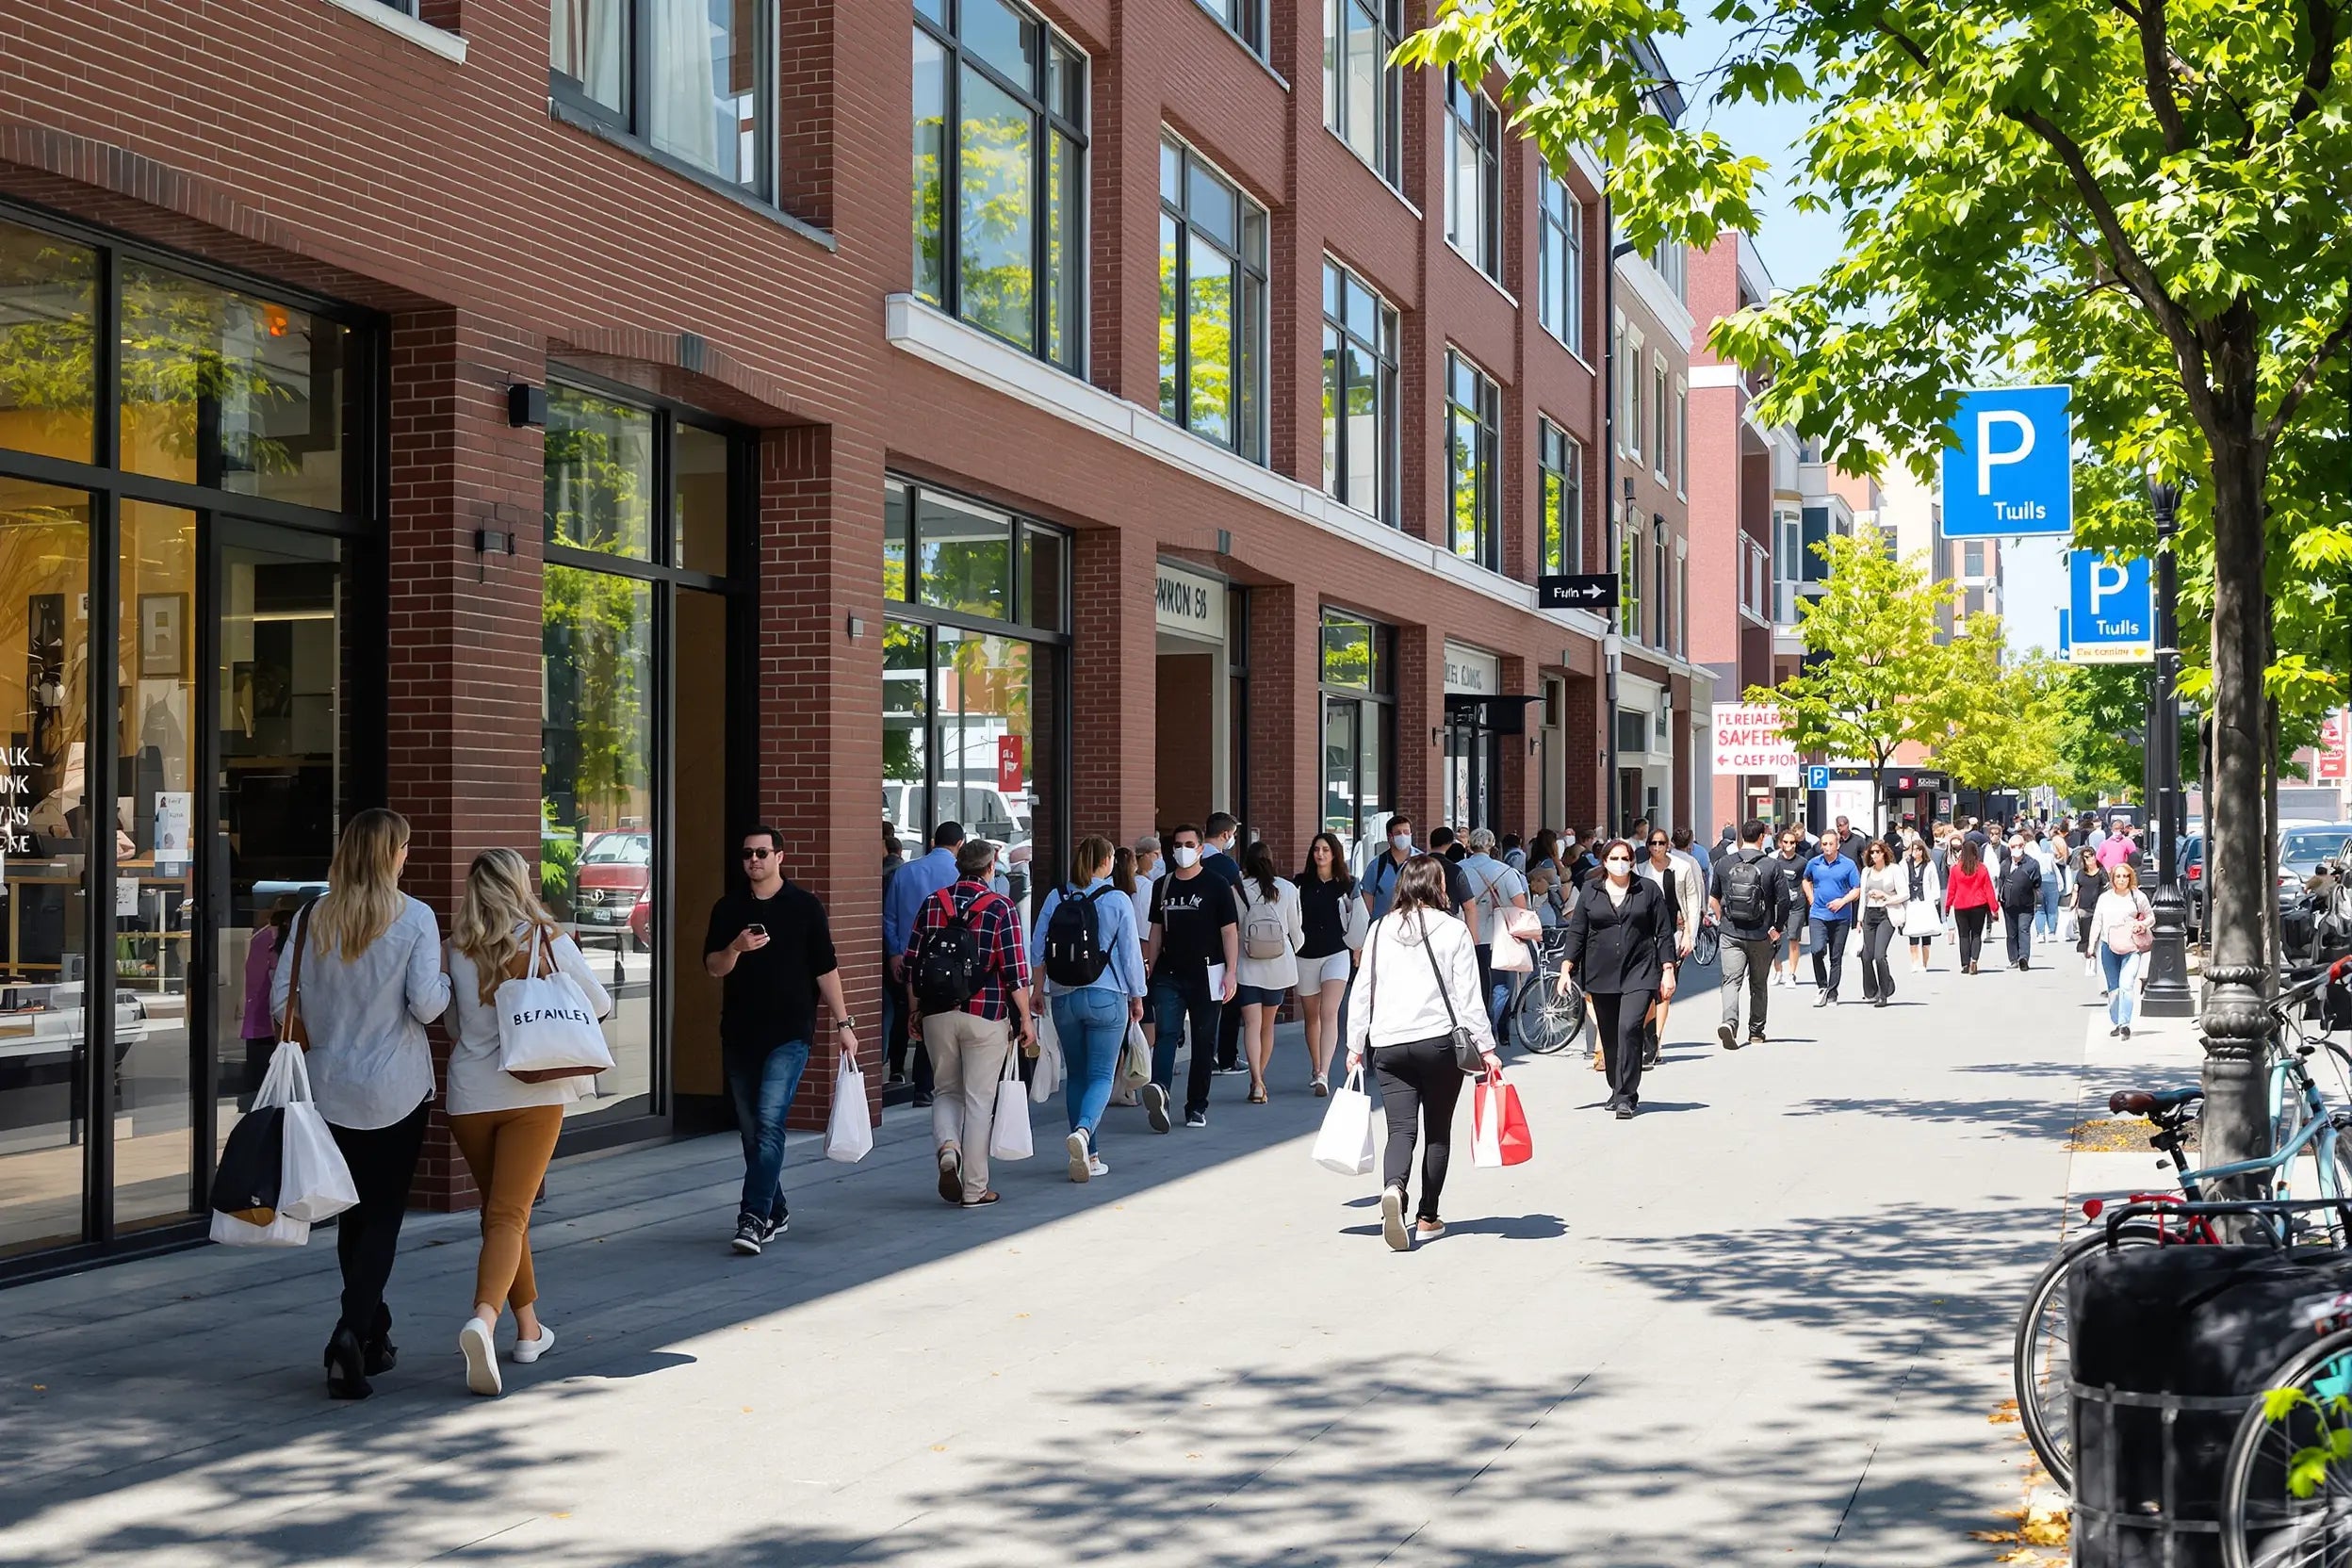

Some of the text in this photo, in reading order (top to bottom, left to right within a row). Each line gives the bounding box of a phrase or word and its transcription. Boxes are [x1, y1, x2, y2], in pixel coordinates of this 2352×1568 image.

[1977, 410, 2035, 496] P
[2090, 561, 2130, 615] P
[1813, 769, 1824, 785] P
